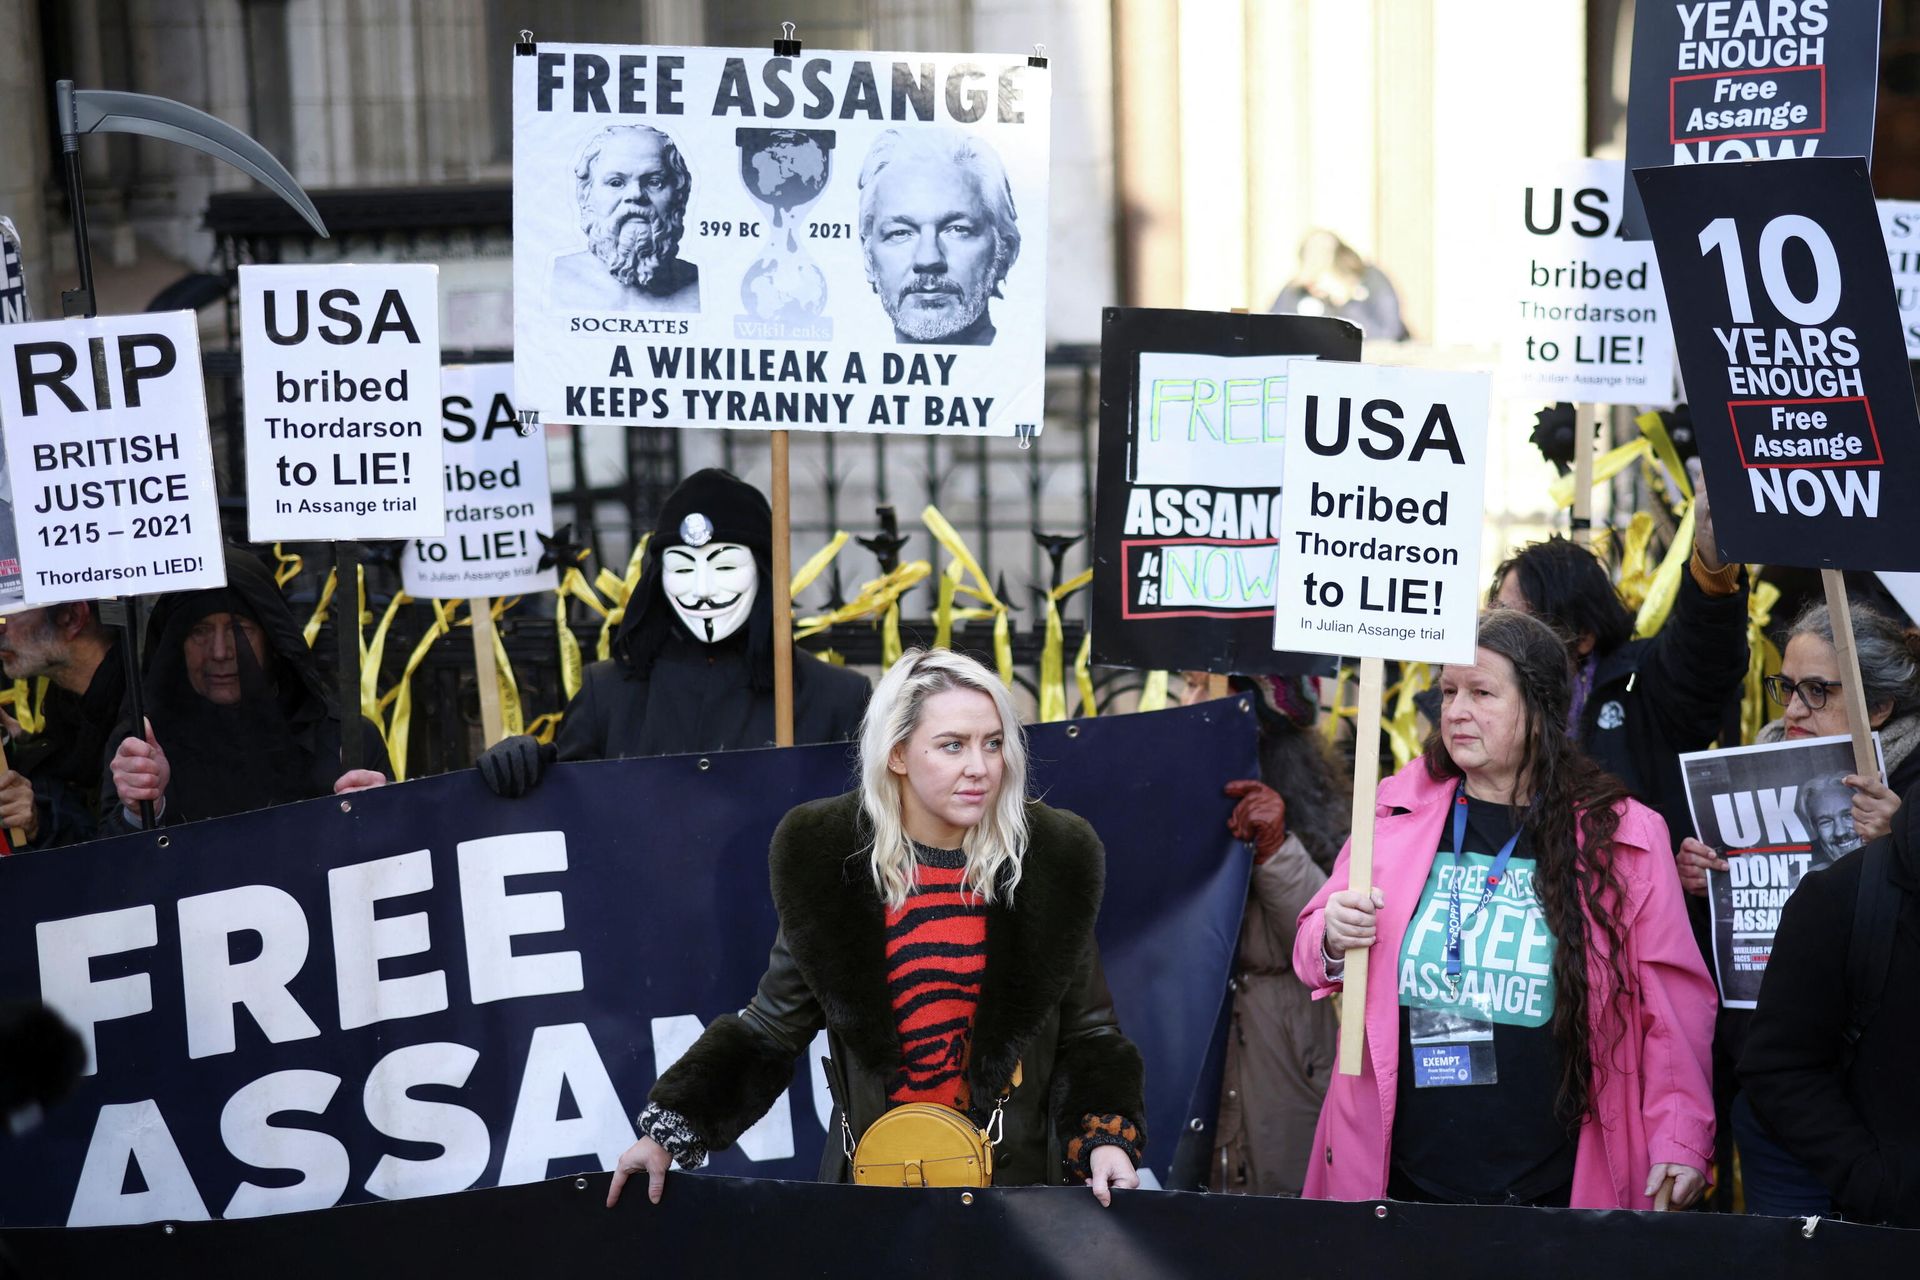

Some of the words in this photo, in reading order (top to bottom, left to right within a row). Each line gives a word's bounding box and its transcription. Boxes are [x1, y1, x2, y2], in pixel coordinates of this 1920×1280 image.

[1677, 0, 1828, 40] YEARS
[1679, 37, 1824, 70] ENOUGH
[538, 53, 684, 115] FREE
[712, 58, 1024, 123] ASSANGE
[1714, 79, 1777, 102] Free
[1686, 102, 1807, 131] Assange
[700, 221, 731, 236] 399
[740, 222, 759, 237] BC
[1524, 186, 1624, 239] US
[810, 223, 850, 238] 2021
[1532, 260, 1647, 290] bribed
[1698, 215, 1841, 325] 10
[264, 289, 420, 345] USA
[570, 316, 690, 336] SOCRATES
[1520, 301, 1657, 322] Thordarson
[1527, 336, 1559, 361] to
[1576, 336, 1643, 364] LIE!
[1713, 327, 1859, 366] YEARS
[14, 334, 176, 416] RIP
[610, 346, 633, 377] A
[647, 346, 827, 382] WIKILEAK
[843, 352, 866, 383] A
[883, 353, 957, 385] DAY
[1728, 367, 1864, 397] ENOUGH
[277, 370, 407, 403] bribed
[442, 393, 524, 443] SA
[566, 386, 669, 419] KEEPS
[683, 390, 854, 423] TYRANNY
[868, 395, 909, 425] AT
[925, 396, 994, 427] BAY
[1150, 376, 1287, 443] FREE
[1772, 407, 1827, 430] Free
[265, 417, 421, 438] Thordarson
[1305, 395, 1465, 464] USA
[34, 433, 178, 471] BRITISH
[1755, 433, 1862, 460] Assange
[277, 456, 317, 486] to
[334, 453, 410, 485] LIE!
[444, 460, 521, 491] ibed
[35, 474, 188, 513] JUSTICE
[277, 500, 291, 513] In
[299, 499, 376, 515] Assange
[383, 497, 416, 511] trial
[1311, 482, 1448, 525] bribed
[1748, 468, 1880, 517] NOW
[446, 503, 534, 522] rdarson
[1124, 488, 1282, 540] ASSAN
[39, 522, 99, 547] 1215
[133, 514, 191, 538] 2021
[416, 540, 447, 561] to
[460, 531, 527, 561] LIE!
[1296, 531, 1457, 565] Thordarson
[37, 566, 146, 585] Thordarson
[154, 557, 202, 575] LIED!
[1165, 547, 1278, 602] NOW
[1304, 573, 1343, 607] to
[1360, 576, 1442, 615] LIE!
[1301, 617, 1312, 629] In
[1317, 619, 1353, 632] Julian
[1358, 623, 1415, 640] Assange
[1421, 628, 1444, 640] trial
[1712, 786, 1810, 847] UK
[1437, 865, 1489, 894] FREE
[1728, 853, 1812, 887] DON'T
[1732, 889, 1795, 907] EXTRAD
[1733, 910, 1781, 931] ASSA
[36, 831, 583, 1075] FREE
[1407, 899, 1550, 976] FREE
[1398, 959, 1548, 1017] ASSANGE
[1422, 1056, 1460, 1067] EXEMPT
[66, 1013, 835, 1226] ASSA
